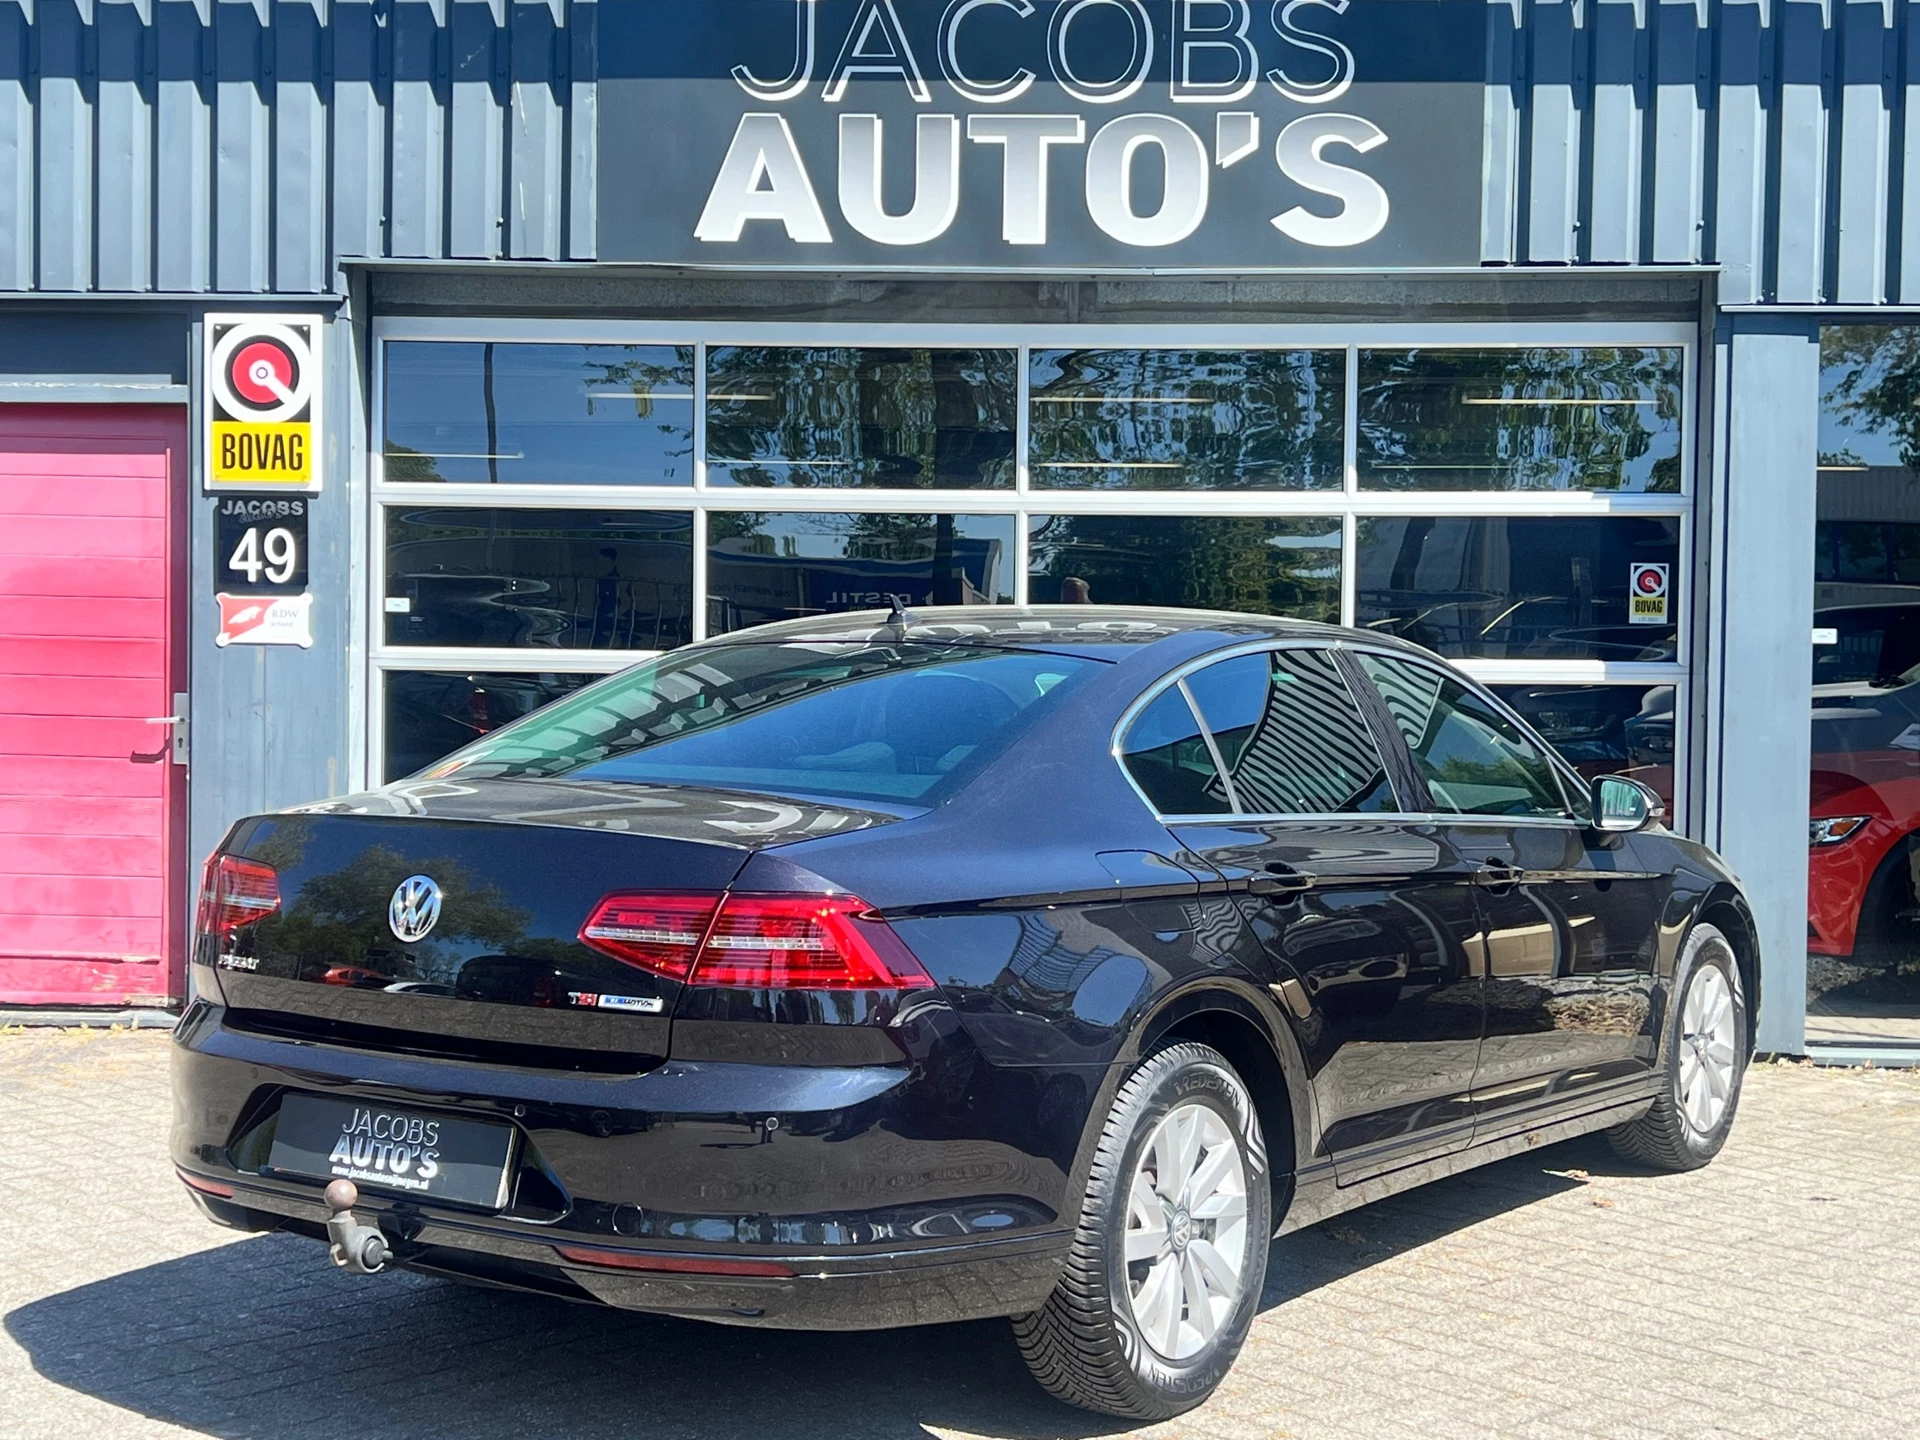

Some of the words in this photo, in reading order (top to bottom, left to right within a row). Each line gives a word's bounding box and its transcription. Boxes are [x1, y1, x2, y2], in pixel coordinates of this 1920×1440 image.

[731, 0, 1355, 102] JACOBS
[694, 112, 1390, 247] AUTO'S
[222, 433, 303, 471] BOVAG
[221, 499, 304, 516] JACOBS
[229, 528, 296, 582] 49
[271, 609, 299, 618] RDW
[1635, 600, 1663, 613] BOVAG
[343, 1108, 440, 1147] JACOBS
[328, 1135, 440, 1179] AUTO'S
